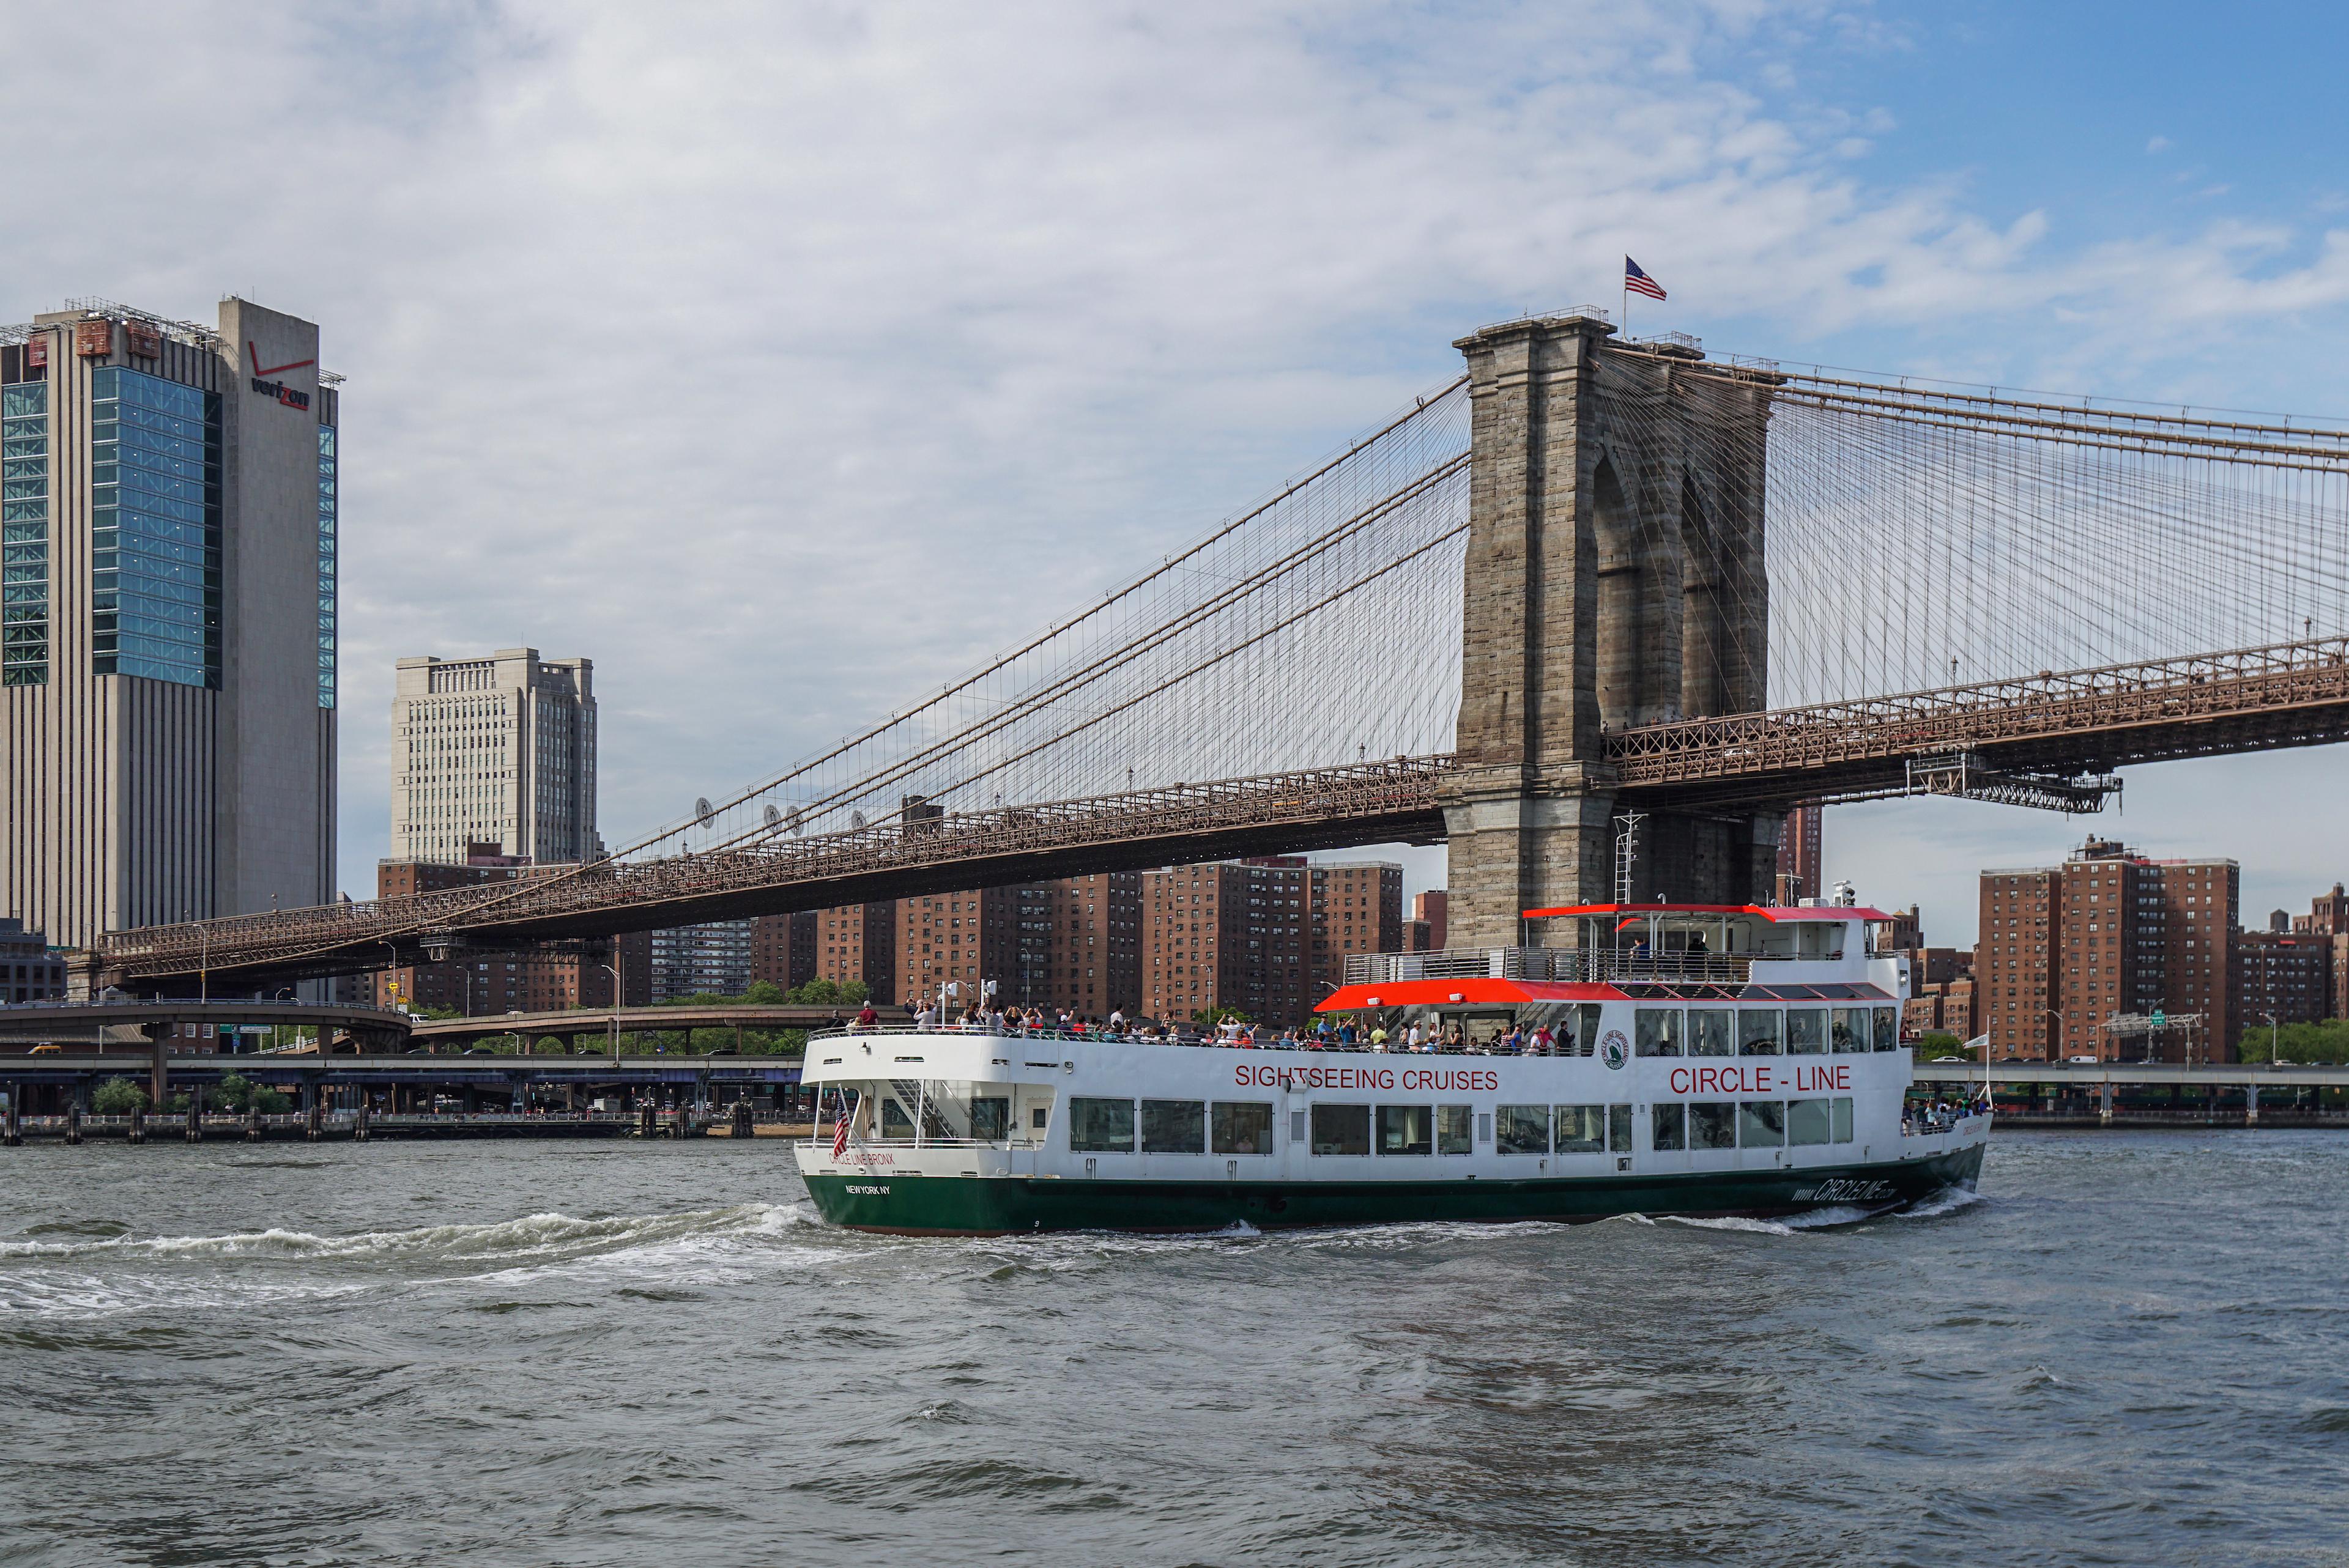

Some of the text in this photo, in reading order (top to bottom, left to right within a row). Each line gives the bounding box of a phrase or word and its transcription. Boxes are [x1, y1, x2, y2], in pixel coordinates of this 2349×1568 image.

[251, 378, 310, 411] verizon
[1615, 1032, 1628, 1062] SIGHTSEEING
[1235, 1065, 1498, 1090] SIGHTSEEING CRUISES
[1671, 1067, 1772, 1094] CIRCLE
[1797, 1066, 1850, 1090] LINE
[851, 1154, 867, 1165] LINE
[868, 1153, 895, 1165] BRONX
[845, 1185, 861, 1194] NEW
[861, 1186, 880, 1194] YORK
